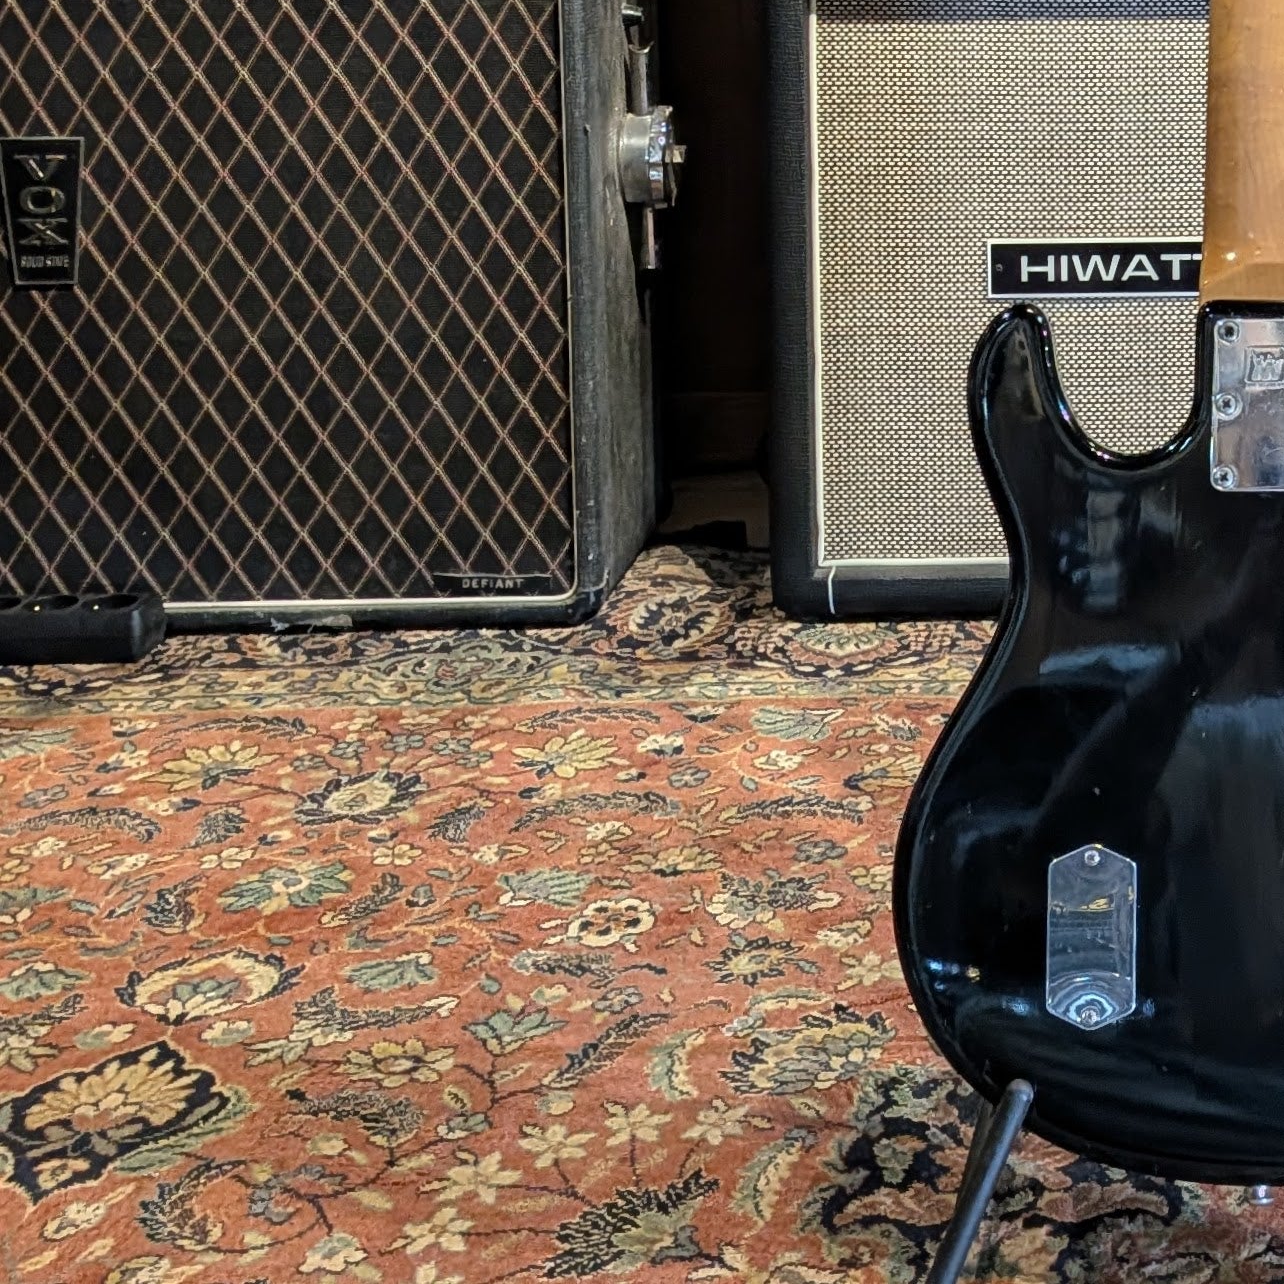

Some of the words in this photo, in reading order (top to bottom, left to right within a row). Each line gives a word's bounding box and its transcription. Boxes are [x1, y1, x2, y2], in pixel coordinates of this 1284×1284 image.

[13, 154, 69, 246] VOX
[1019, 253, 1203, 283] HIWAT
[461, 577, 525, 589] DEFIANT
